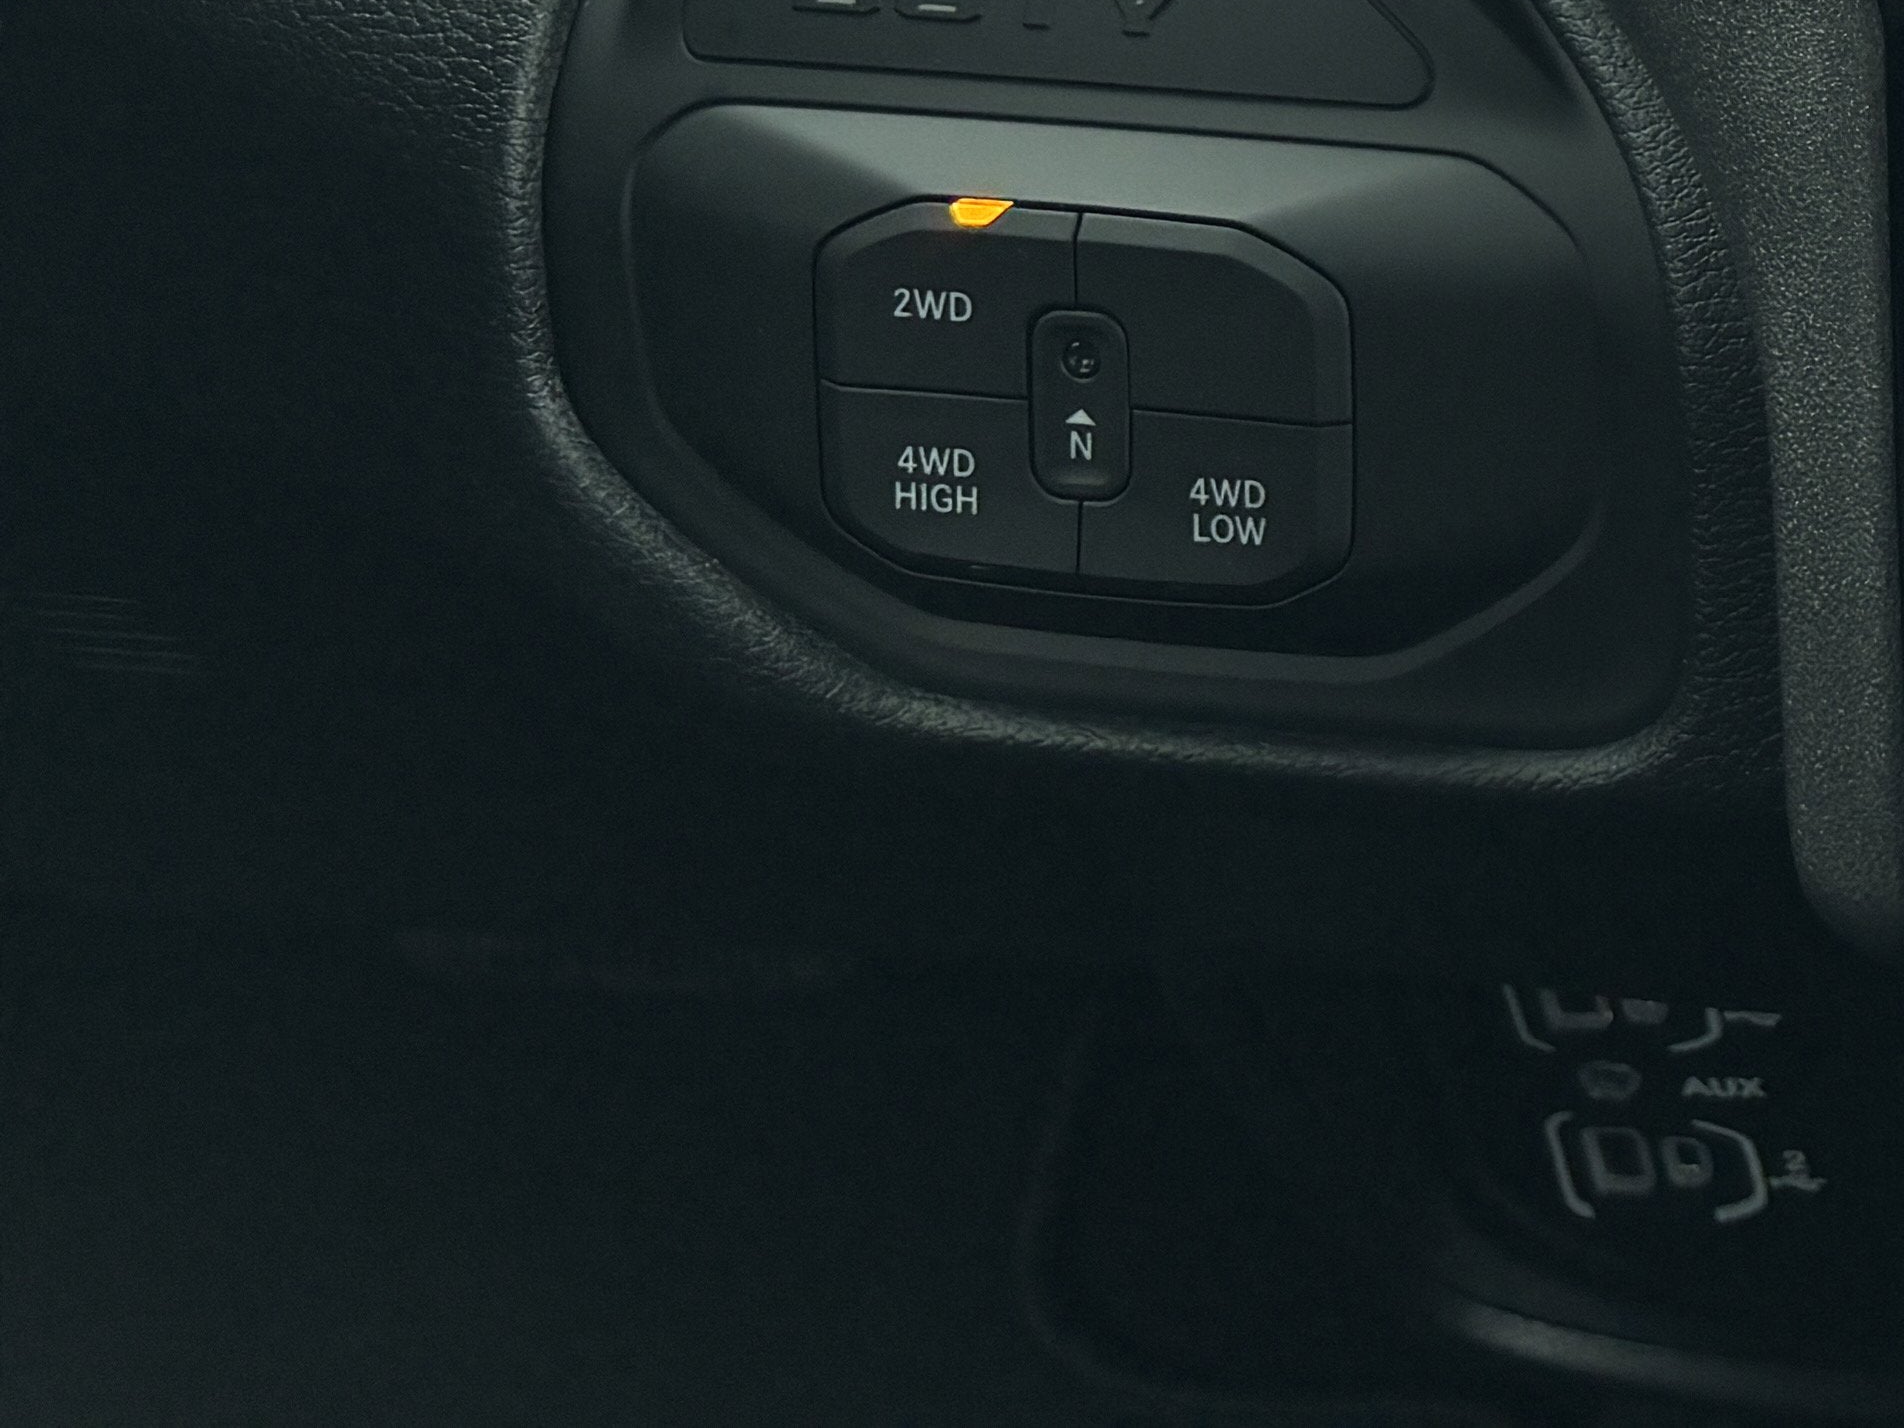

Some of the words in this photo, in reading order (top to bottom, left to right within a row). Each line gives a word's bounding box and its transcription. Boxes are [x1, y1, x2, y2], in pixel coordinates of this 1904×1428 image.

[892, 288, 972, 323] 2WD
[1069, 429, 1092, 460] N
[897, 445, 976, 478] 4WD
[895, 482, 979, 516] HIGH
[1190, 478, 1267, 511] 4WD
[1193, 514, 1268, 547] LOW
[1681, 1076, 1766, 1098] AUX
